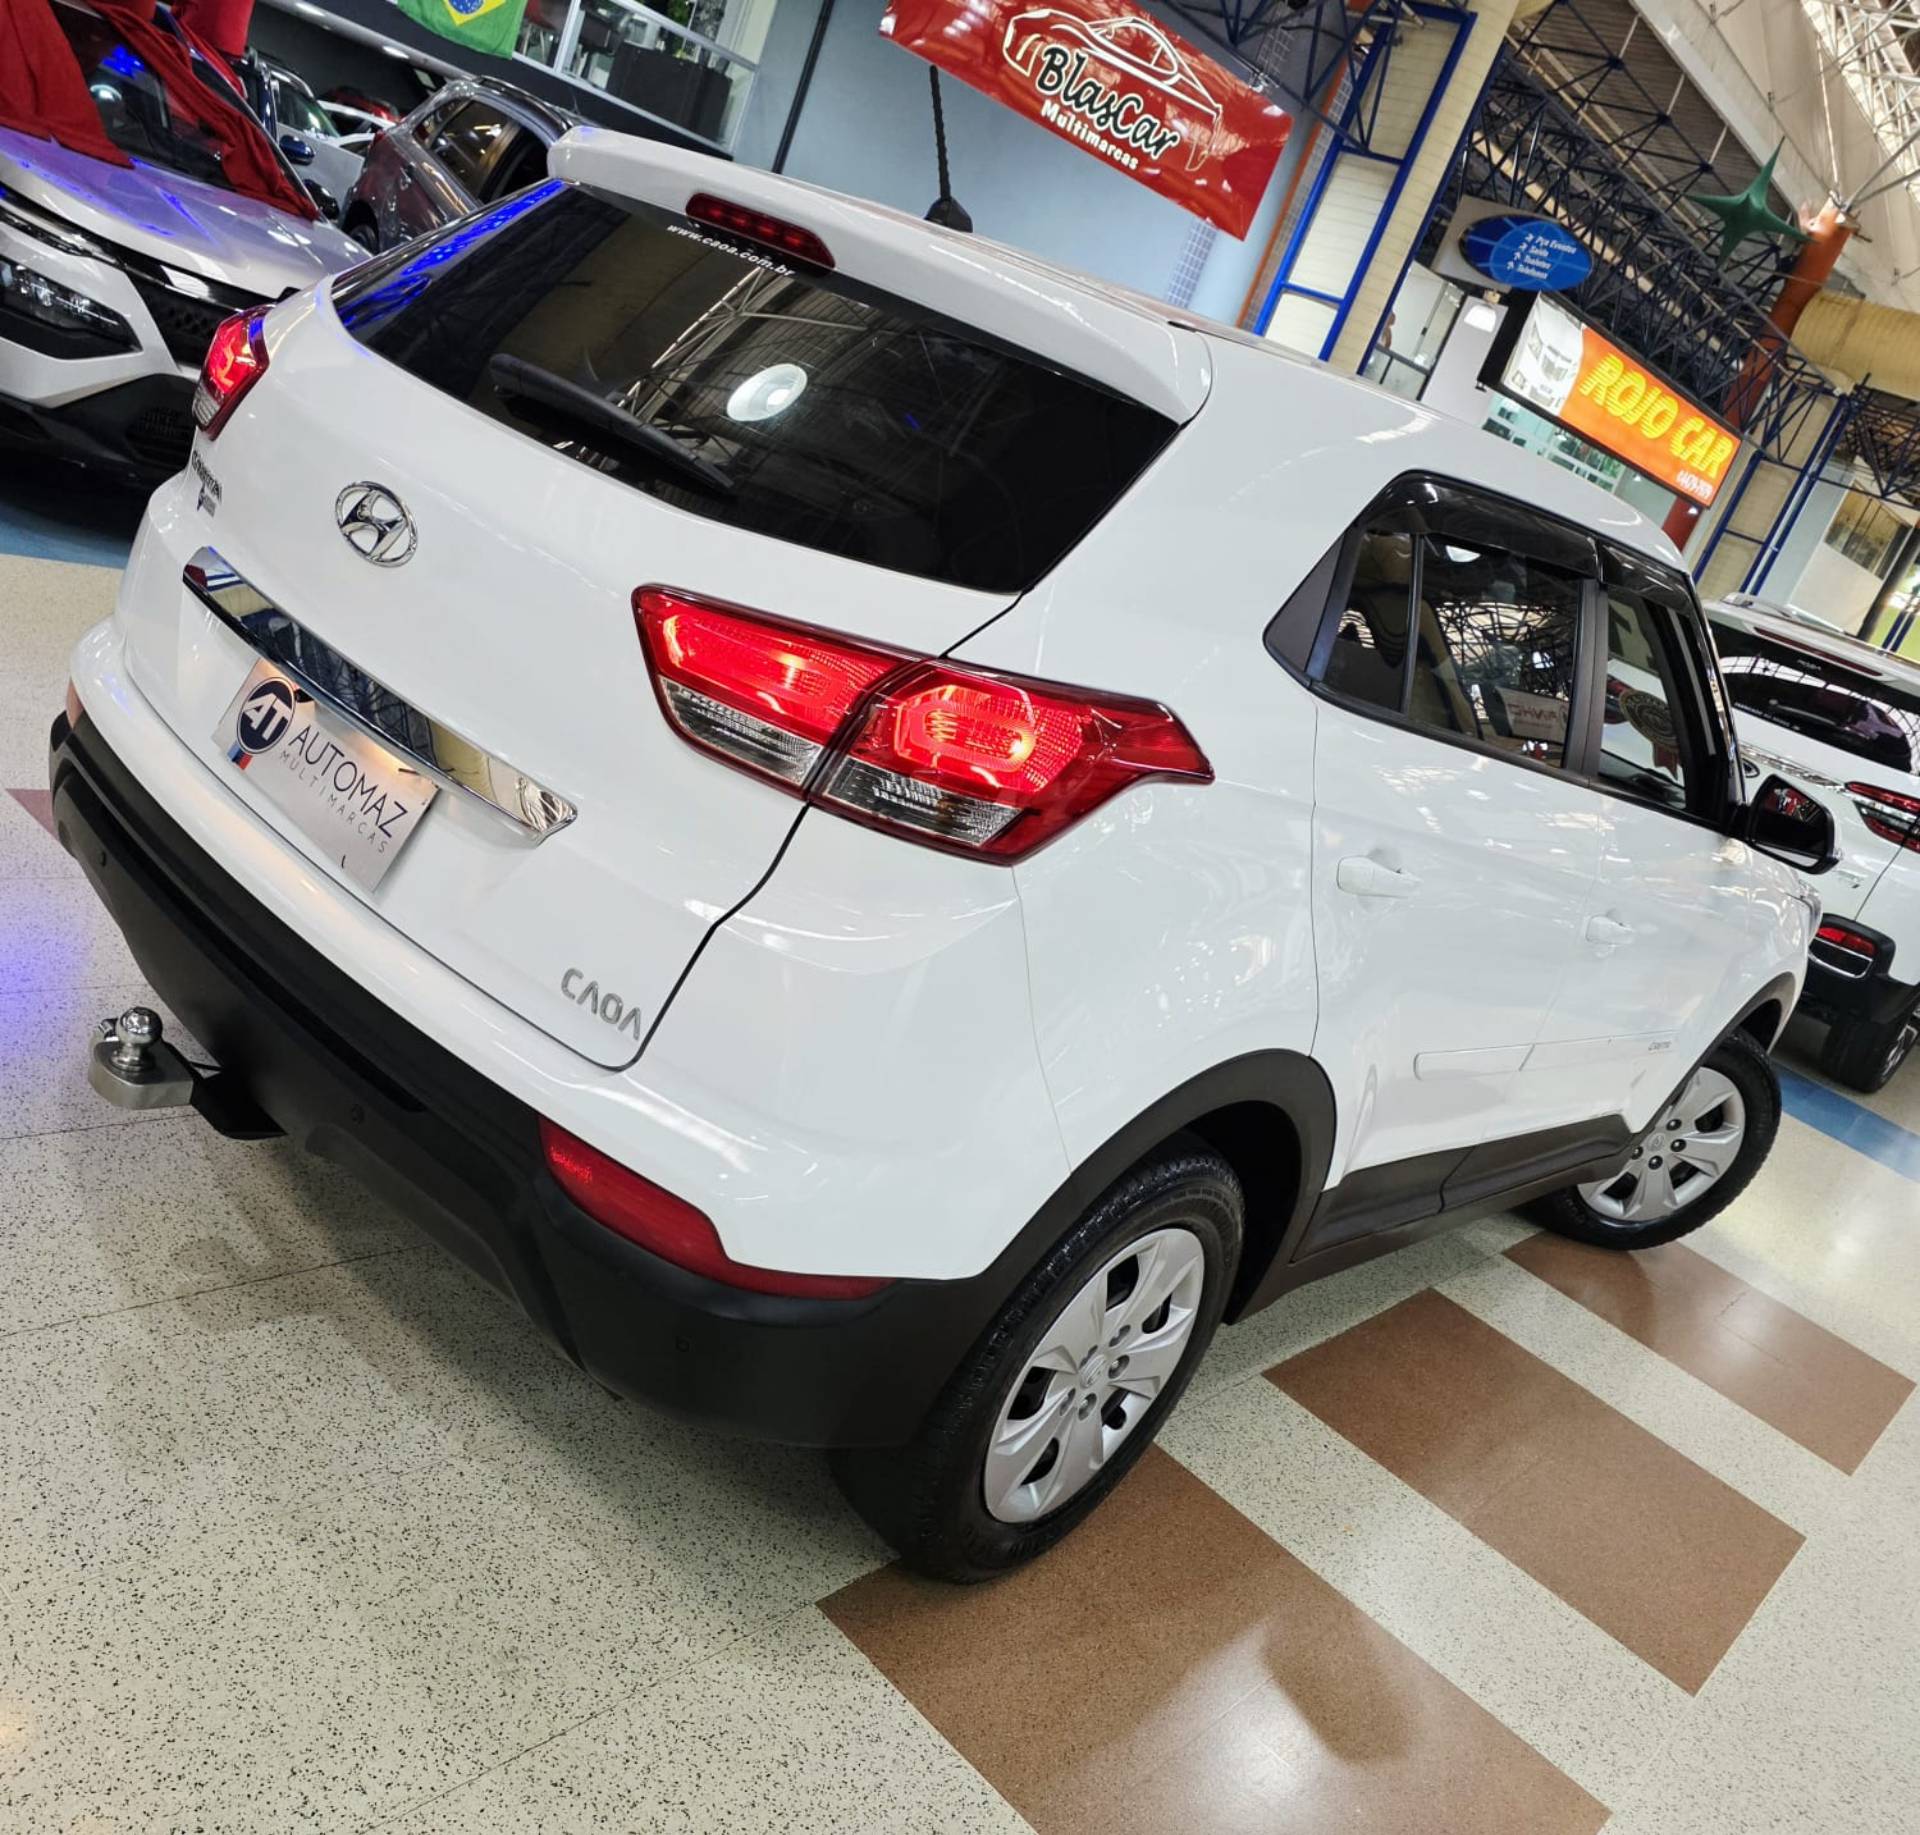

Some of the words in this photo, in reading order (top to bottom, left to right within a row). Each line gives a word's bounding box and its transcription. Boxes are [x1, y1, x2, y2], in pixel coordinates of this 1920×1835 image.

[1037, 44, 1179, 158] BlasCar
[1041, 100, 1138, 170] Multimarcas
[667, 224, 796, 277] www.caoa.com.br
[1578, 352, 1679, 440] ROJO
[1669, 417, 1734, 479] CAR
[279, 750, 389, 855] MULTIMARCAS
[288, 724, 409, 838] AUTOMAZ
[561, 967, 641, 1041] CAOA
